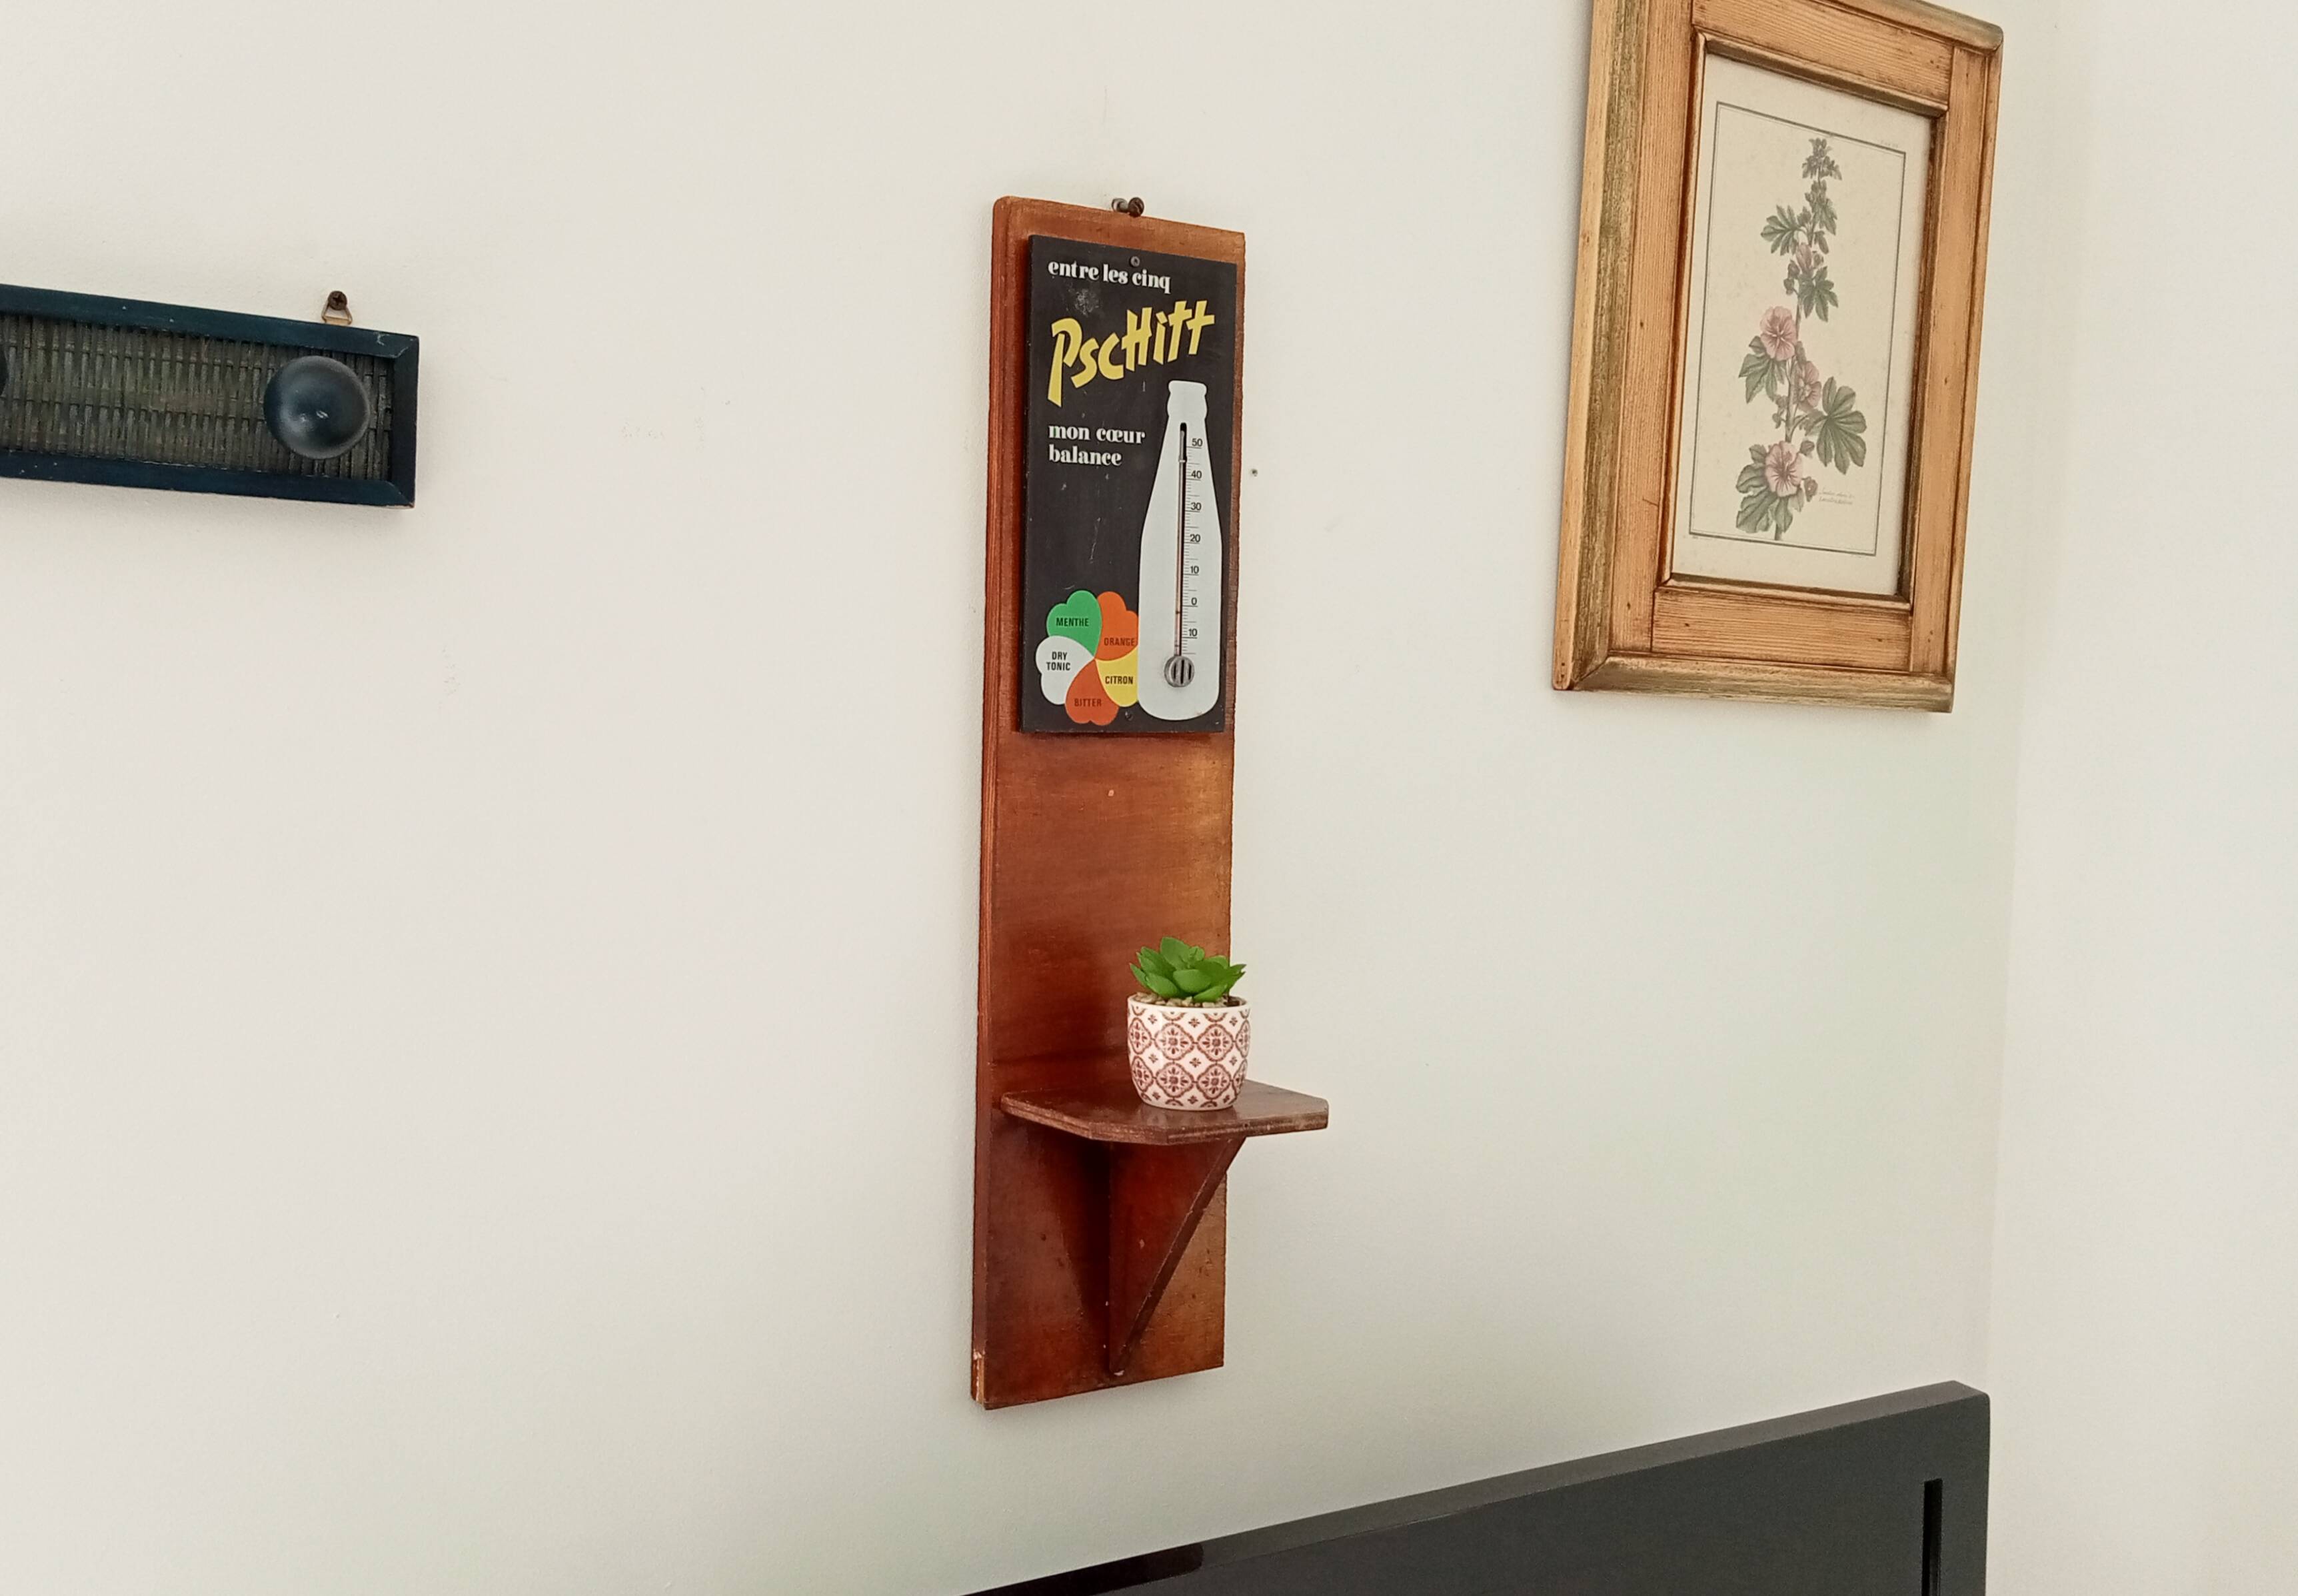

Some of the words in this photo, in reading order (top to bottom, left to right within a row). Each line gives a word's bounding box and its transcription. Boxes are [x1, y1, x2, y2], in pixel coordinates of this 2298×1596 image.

[1048, 261, 1099, 281] entre
[1102, 264, 1128, 285] les
[1132, 269, 1171, 294] cinq
[1048, 424, 1090, 440] mon
[1096, 429, 1146, 444] cœur
[1192, 438, 1203, 447] 50
[1048, 444, 1122, 466] balance
[1190, 470, 1202, 480] 40
[1190, 501, 1202, 511] 30
[1189, 534, 1201, 543] 20
[1190, 565, 1200, 574] 10
[1190, 596, 1198, 606] 0
[1056, 617, 1089, 627] MENTHE
[1188, 628, 1198, 638] 10
[1104, 637, 1136, 646] ORANGE
[1052, 651, 1068, 660] DRY
[1046, 661, 1071, 670] TONIC
[1104, 675, 1134, 685] CITRON
[1074, 698, 1102, 708] BITTER
